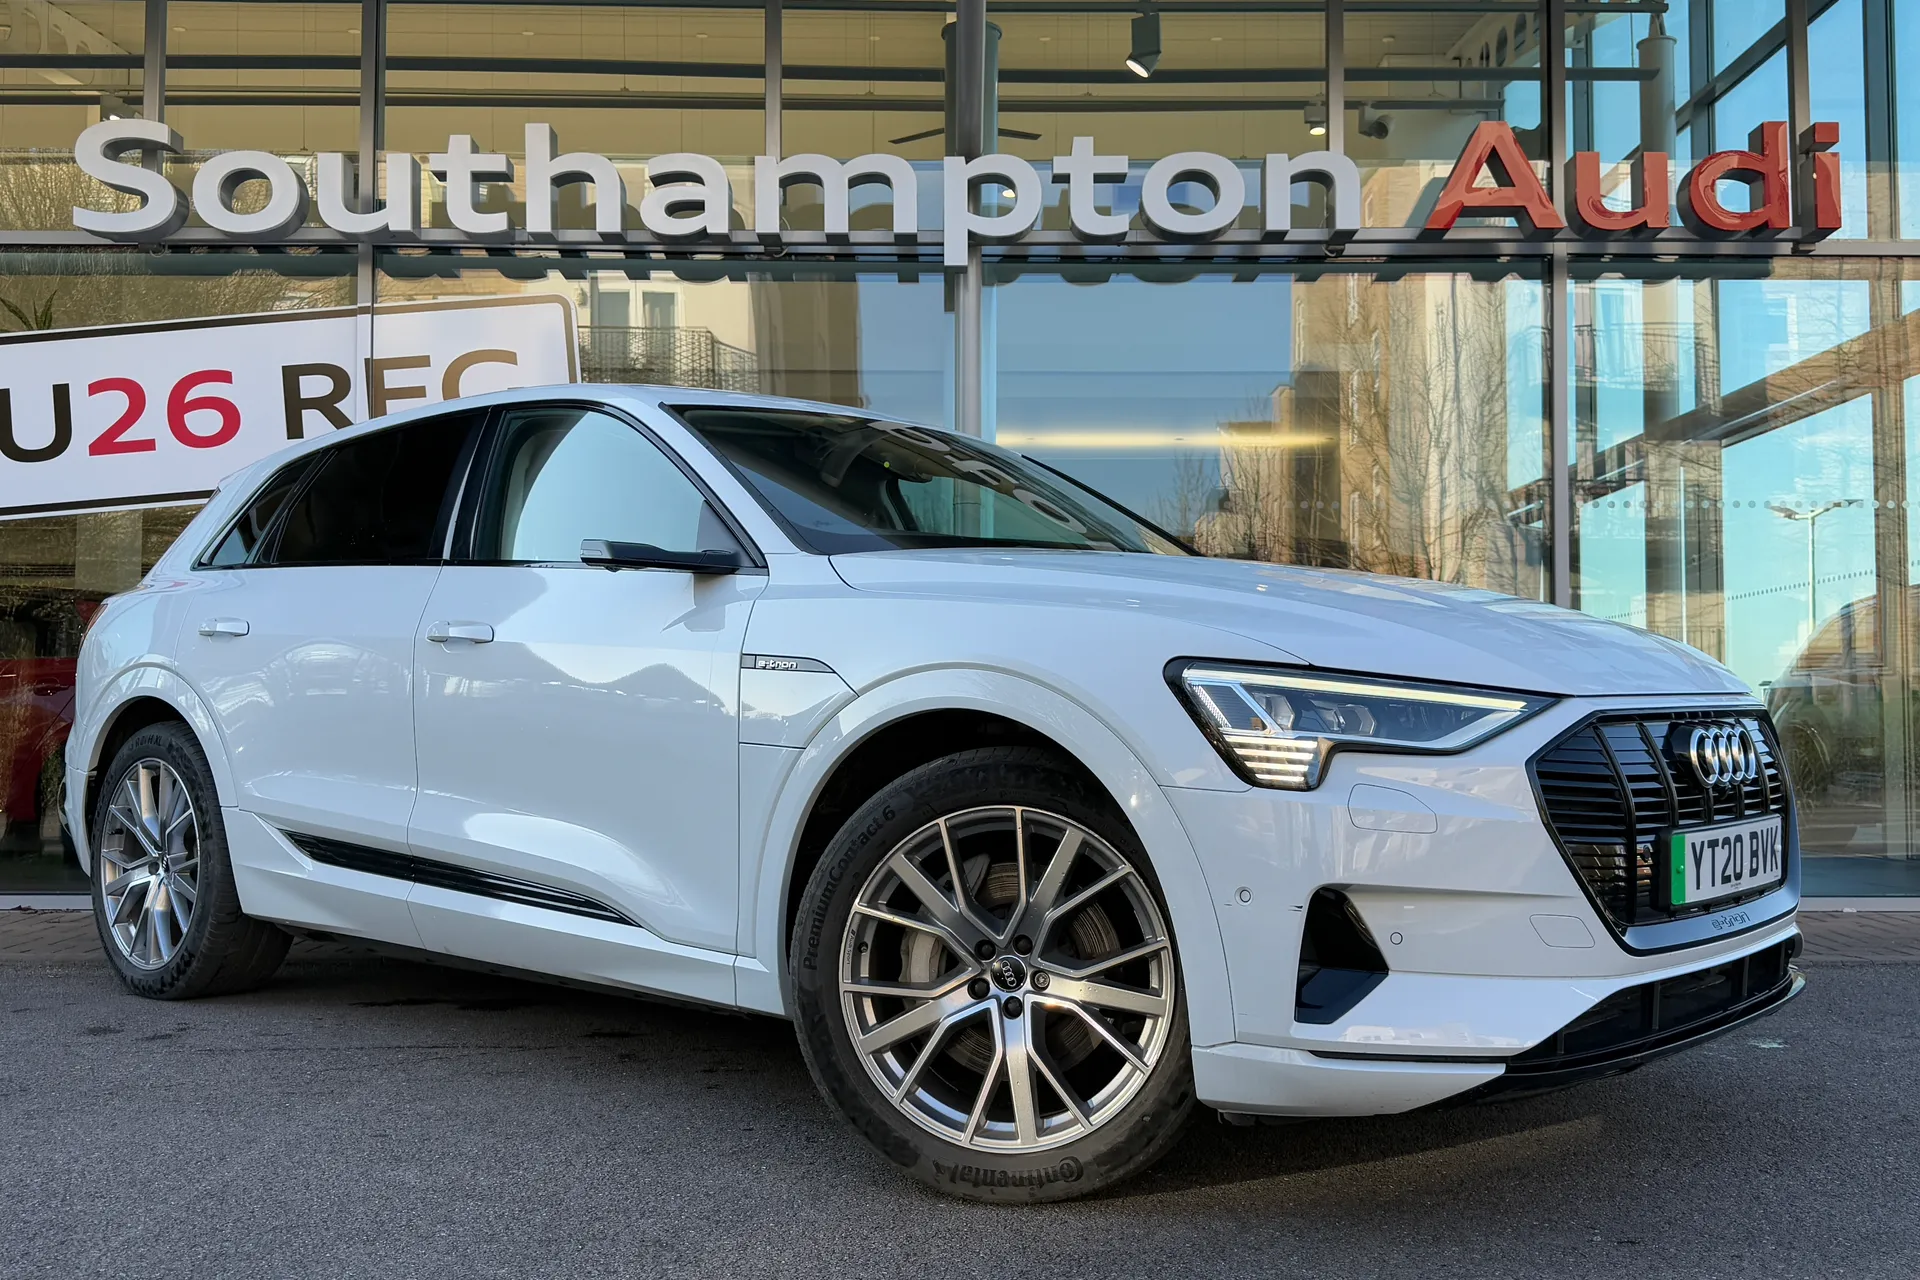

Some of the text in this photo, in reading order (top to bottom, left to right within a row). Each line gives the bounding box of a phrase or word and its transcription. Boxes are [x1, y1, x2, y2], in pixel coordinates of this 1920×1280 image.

[73, 119, 1842, 267] Southampton Audi
[758, 659, 798, 669] e-tron
[1691, 827, 1779, 890] YT20 BVK
[803, 804, 897, 971] PremiumContact 6
[1711, 911, 1750, 930] e-tron
[949, 1156, 1084, 1191] Continental
